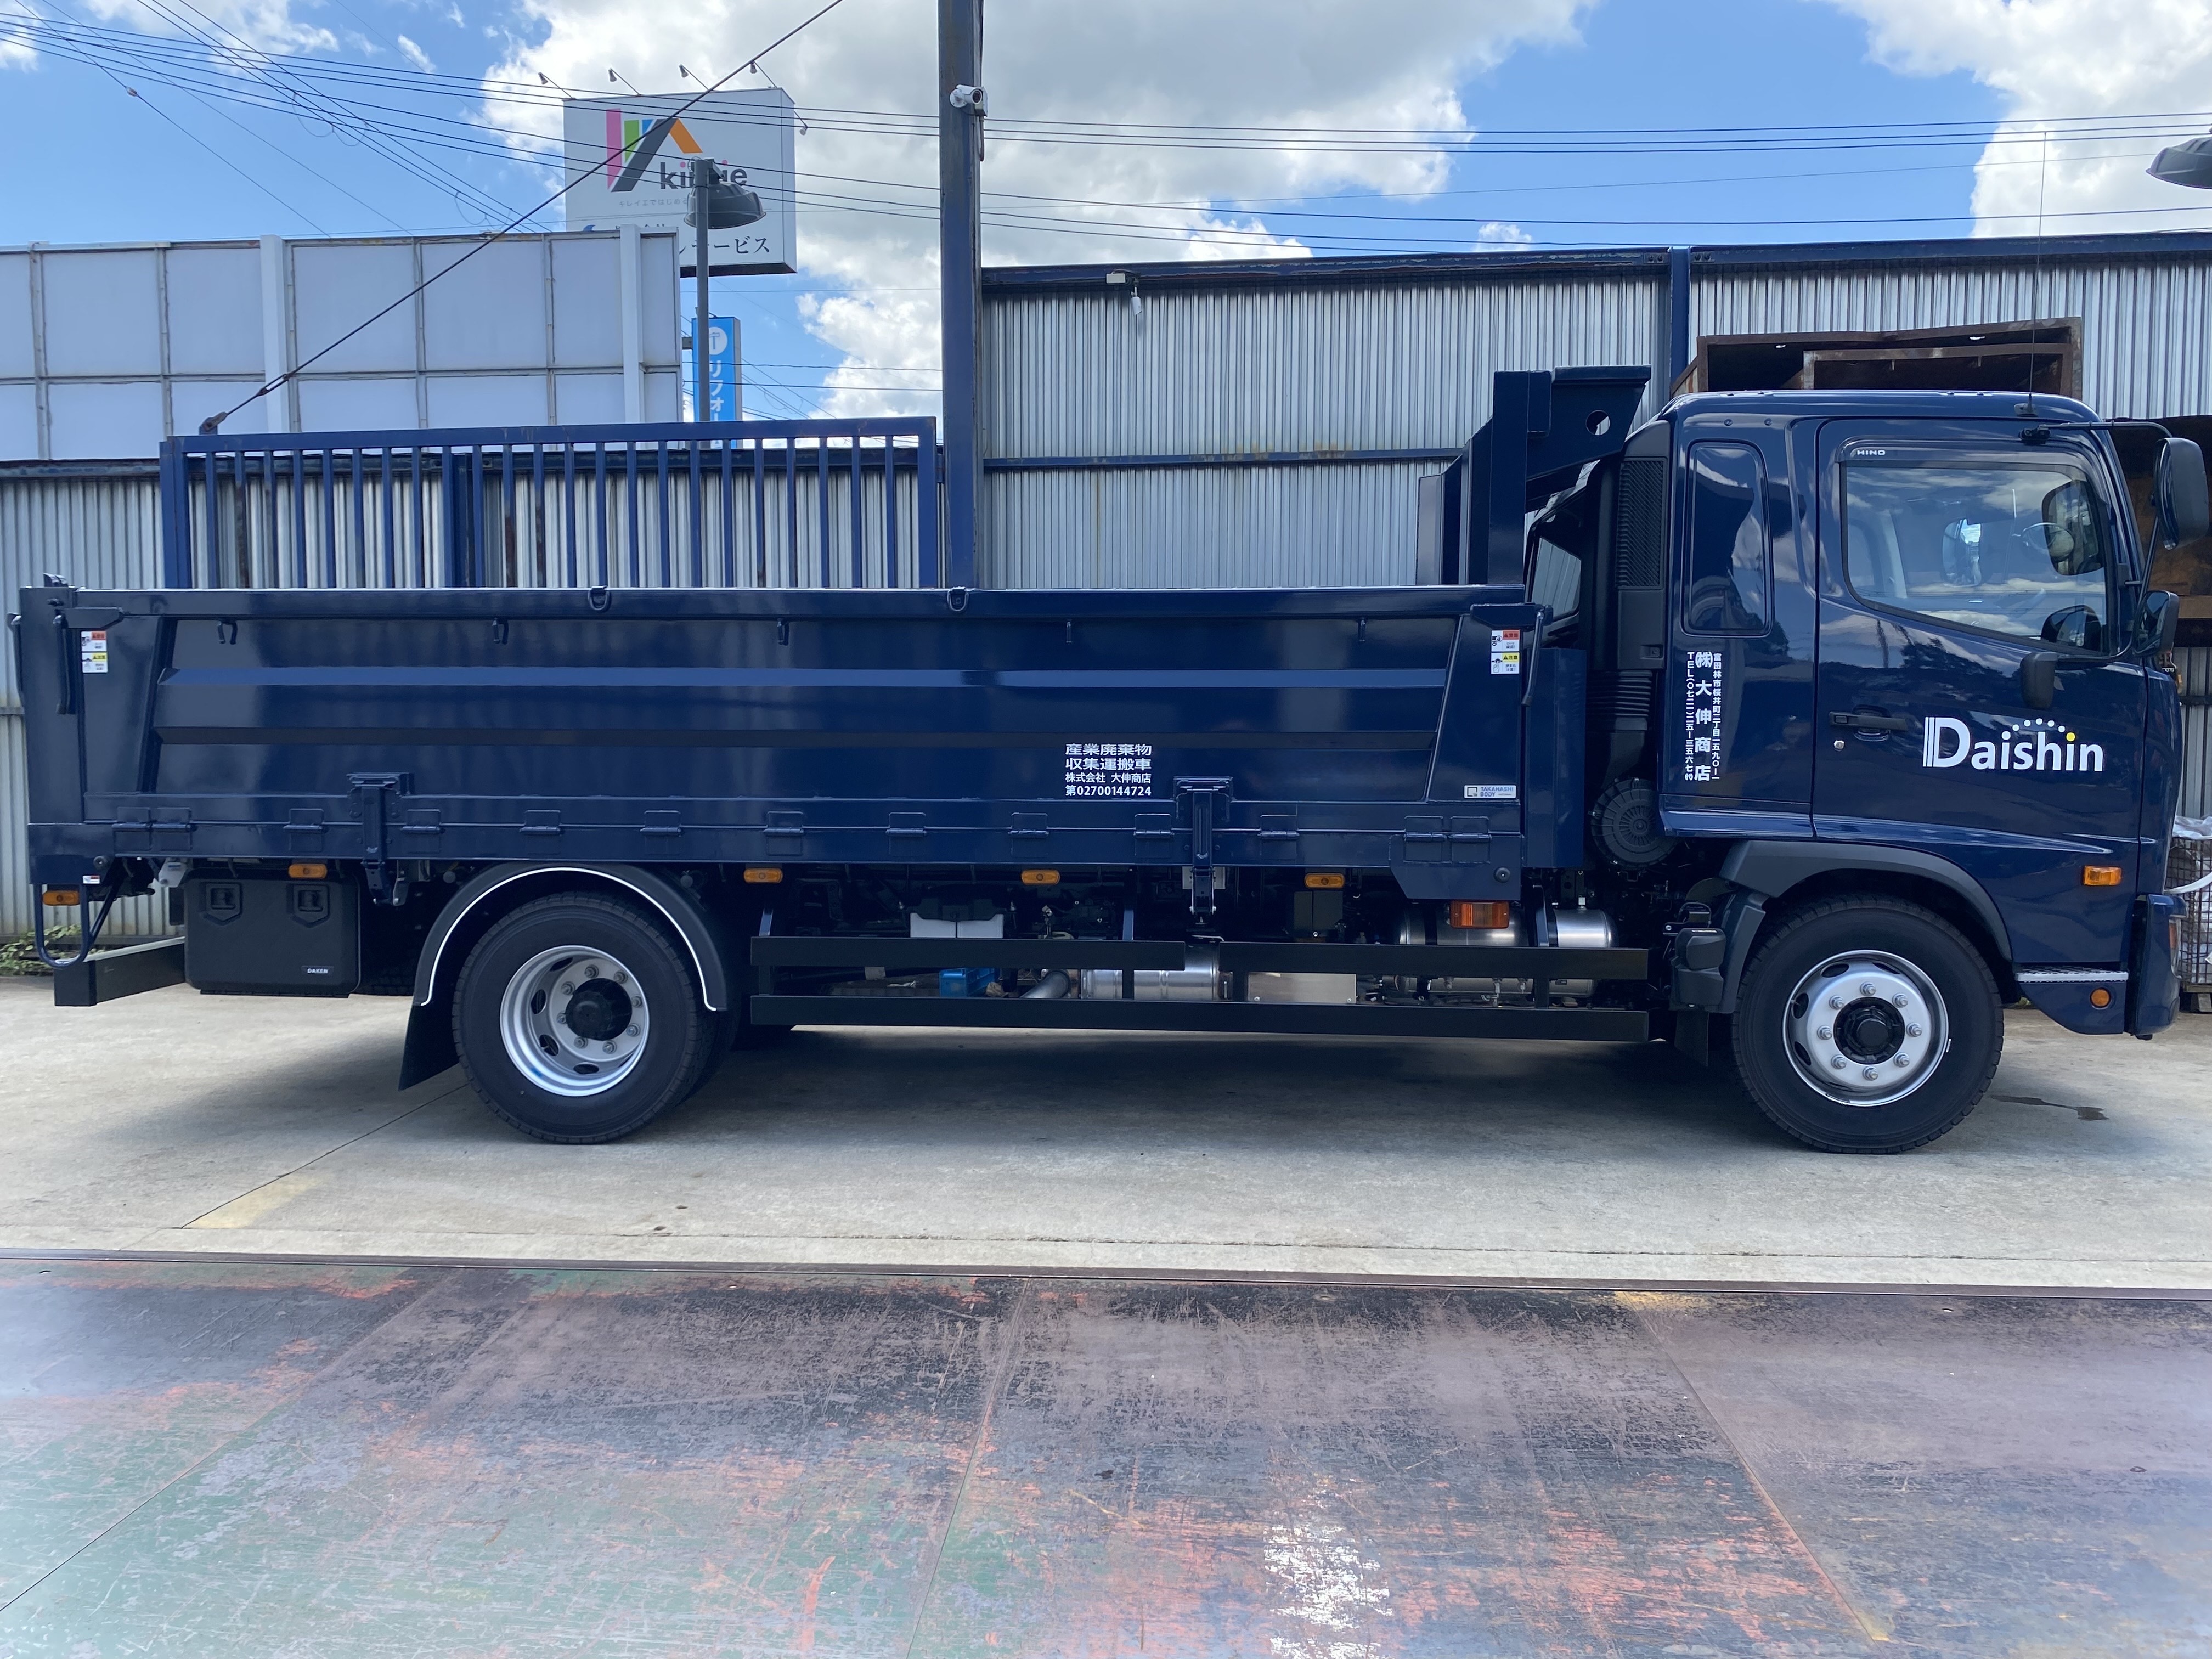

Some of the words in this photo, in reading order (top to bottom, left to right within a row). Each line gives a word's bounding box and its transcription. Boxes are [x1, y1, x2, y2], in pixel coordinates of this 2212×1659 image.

[1065, 743, 1152, 756] 産業廃棄物
[1922, 716, 2103, 772] Daishin
[1065, 757, 1152, 771] 収集運搬車
[1065, 772, 1105, 783] 株式会社
[1111, 772, 1152, 783] 大伸商店
[1065, 785, 1152, 796] 第02700144724
